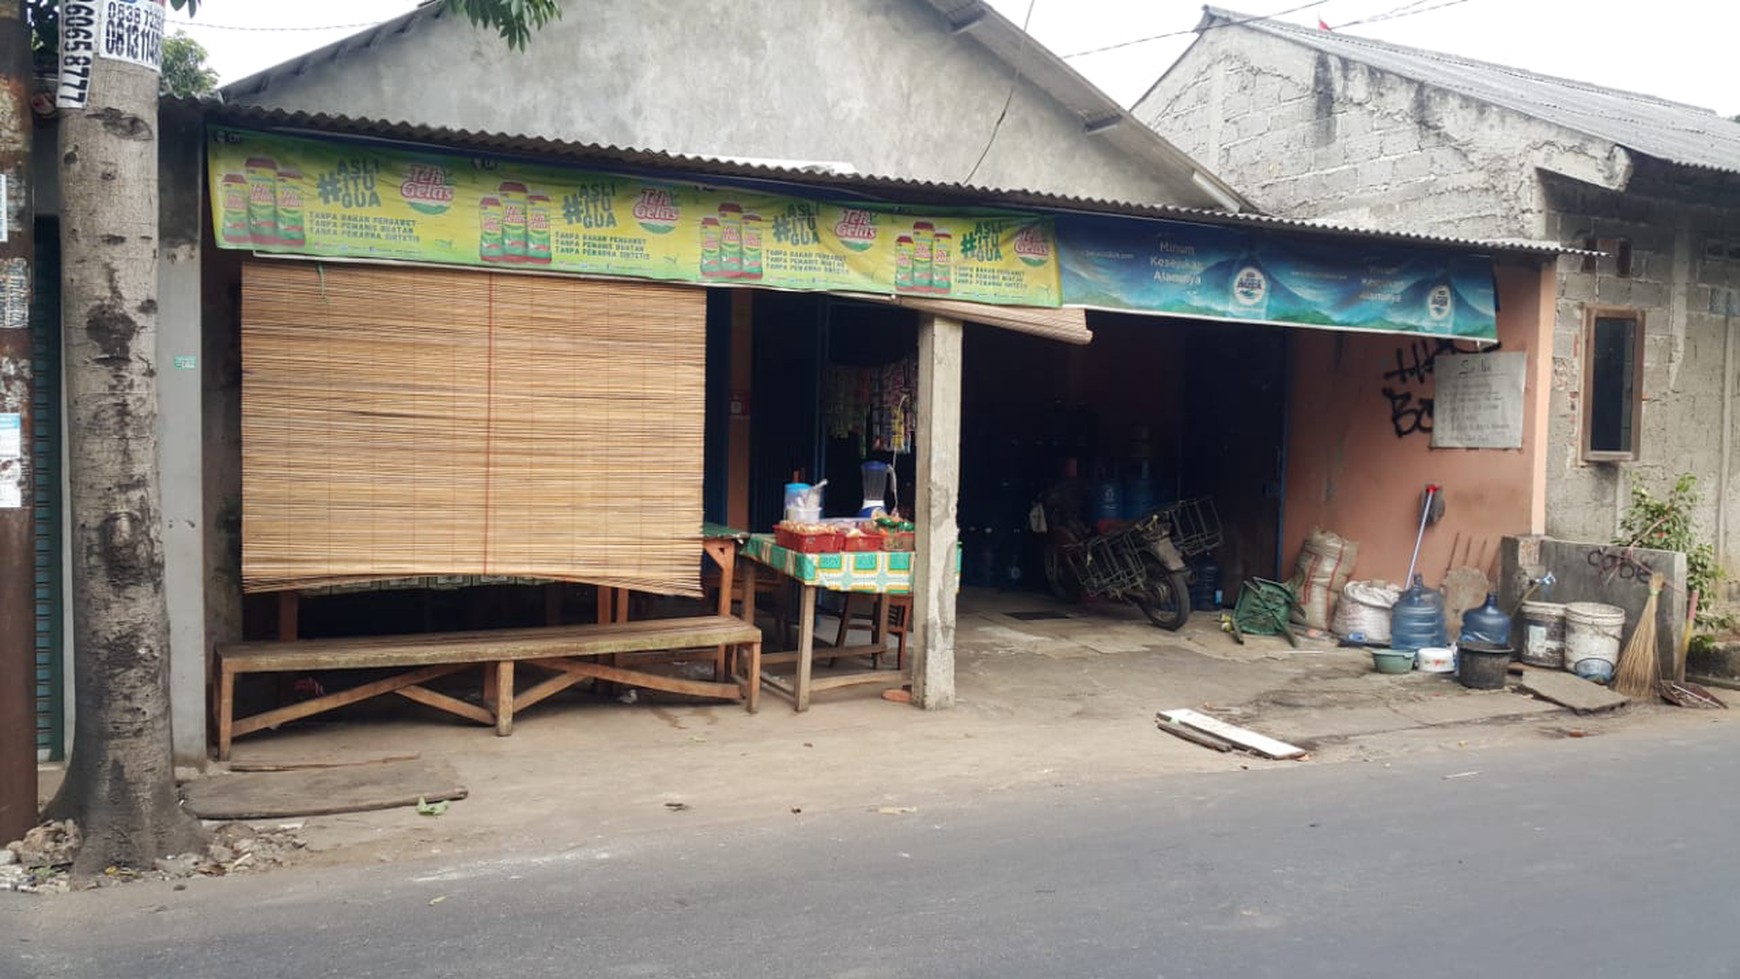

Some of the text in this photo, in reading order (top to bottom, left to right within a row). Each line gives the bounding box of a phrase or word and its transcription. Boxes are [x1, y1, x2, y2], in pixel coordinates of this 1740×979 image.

[337, 159, 380, 176] ASLI
[580, 182, 616, 198] ASLI
[342, 191, 381, 208] GUA
[583, 212, 617, 228] GUA
